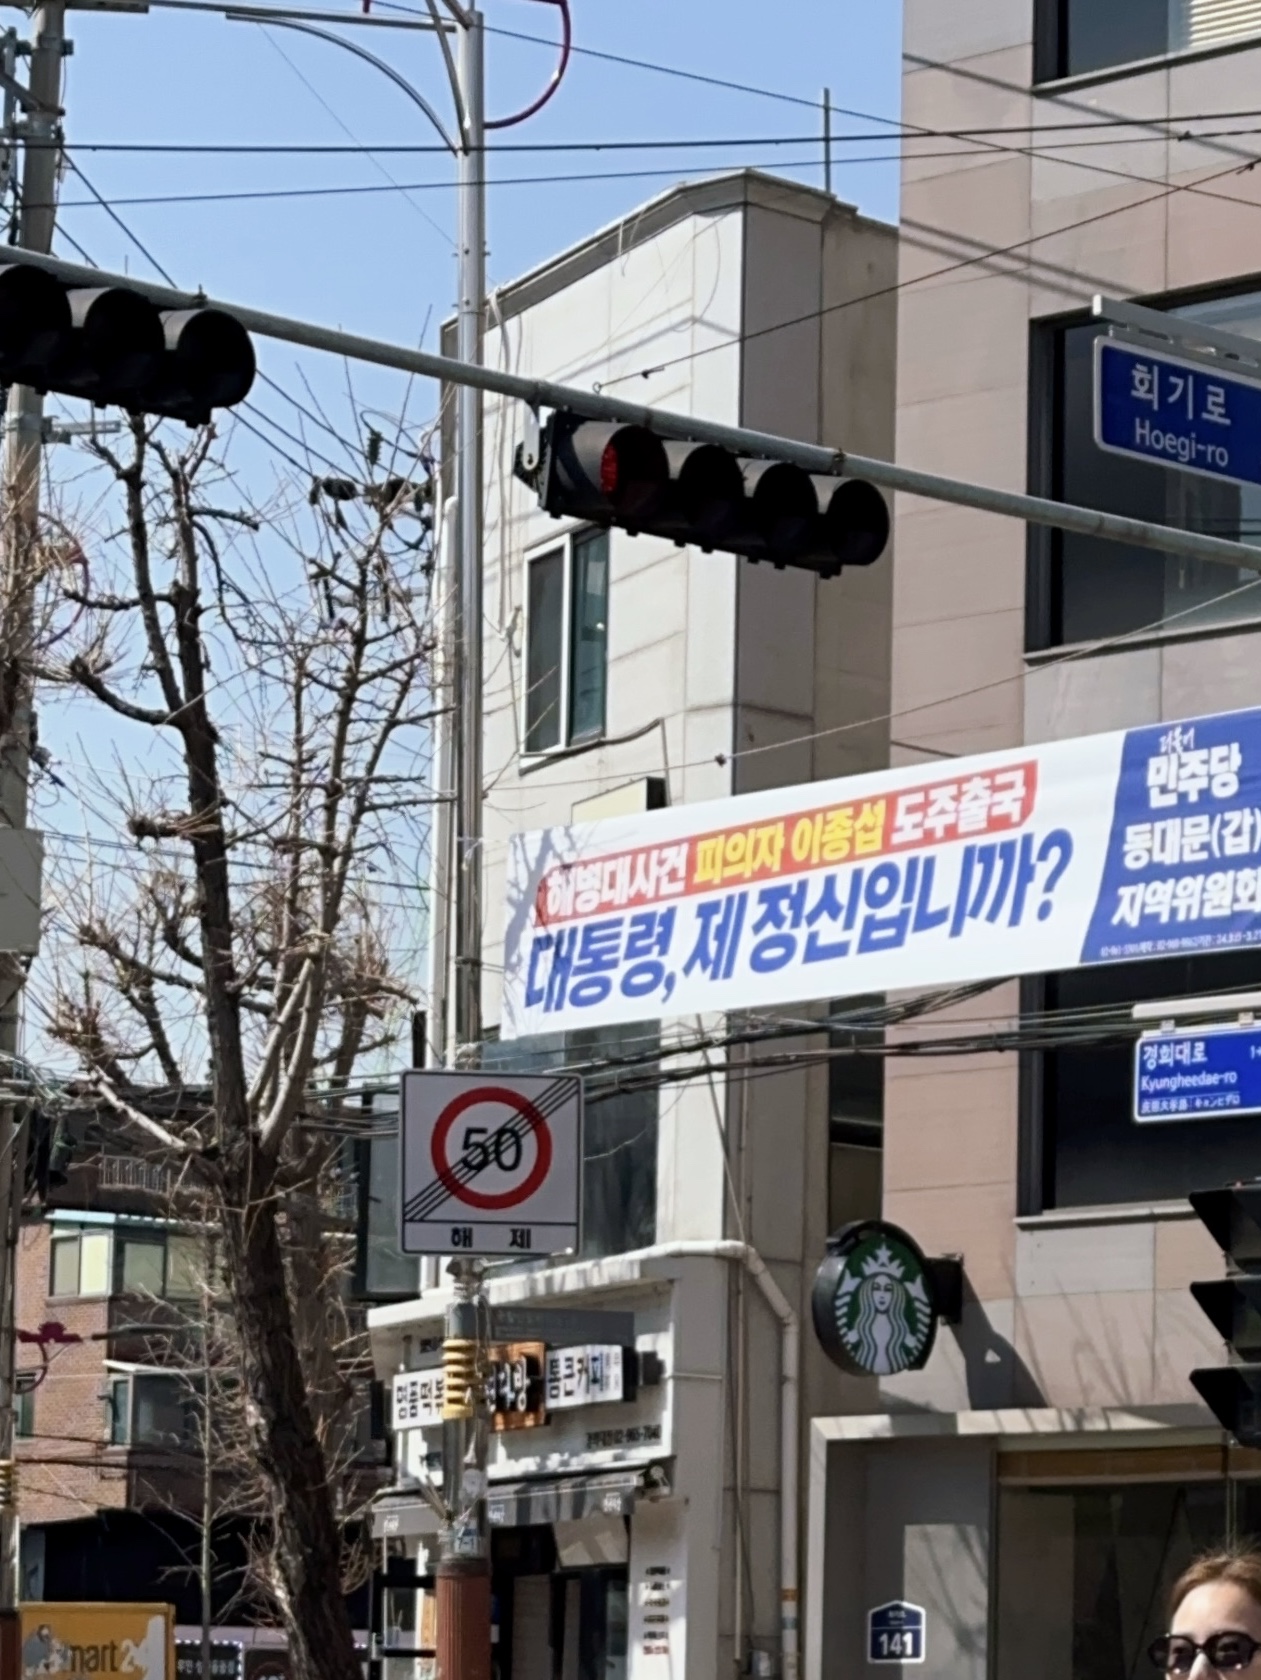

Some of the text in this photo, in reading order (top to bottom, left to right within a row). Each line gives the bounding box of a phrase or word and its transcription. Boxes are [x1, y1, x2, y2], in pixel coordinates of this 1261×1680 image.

[1130, 363, 1231, 425] 회기로
[1134, 417, 1229, 467] Hoegi-ro
[1147, 743, 1242, 809] 민주당
[694, 820, 786, 885] 피의자
[790, 798, 887, 865] 이종섭
[891, 769, 1027, 846] 도주출국
[525, 905, 678, 1014] 대통령,
[1143, 1041, 1208, 1070] 경희대로
[1141, 1070, 1238, 1093] Kyungheedae-ro
[462, 1127, 522, 1171] 50
[880, 1632, 912, 1656] 141
